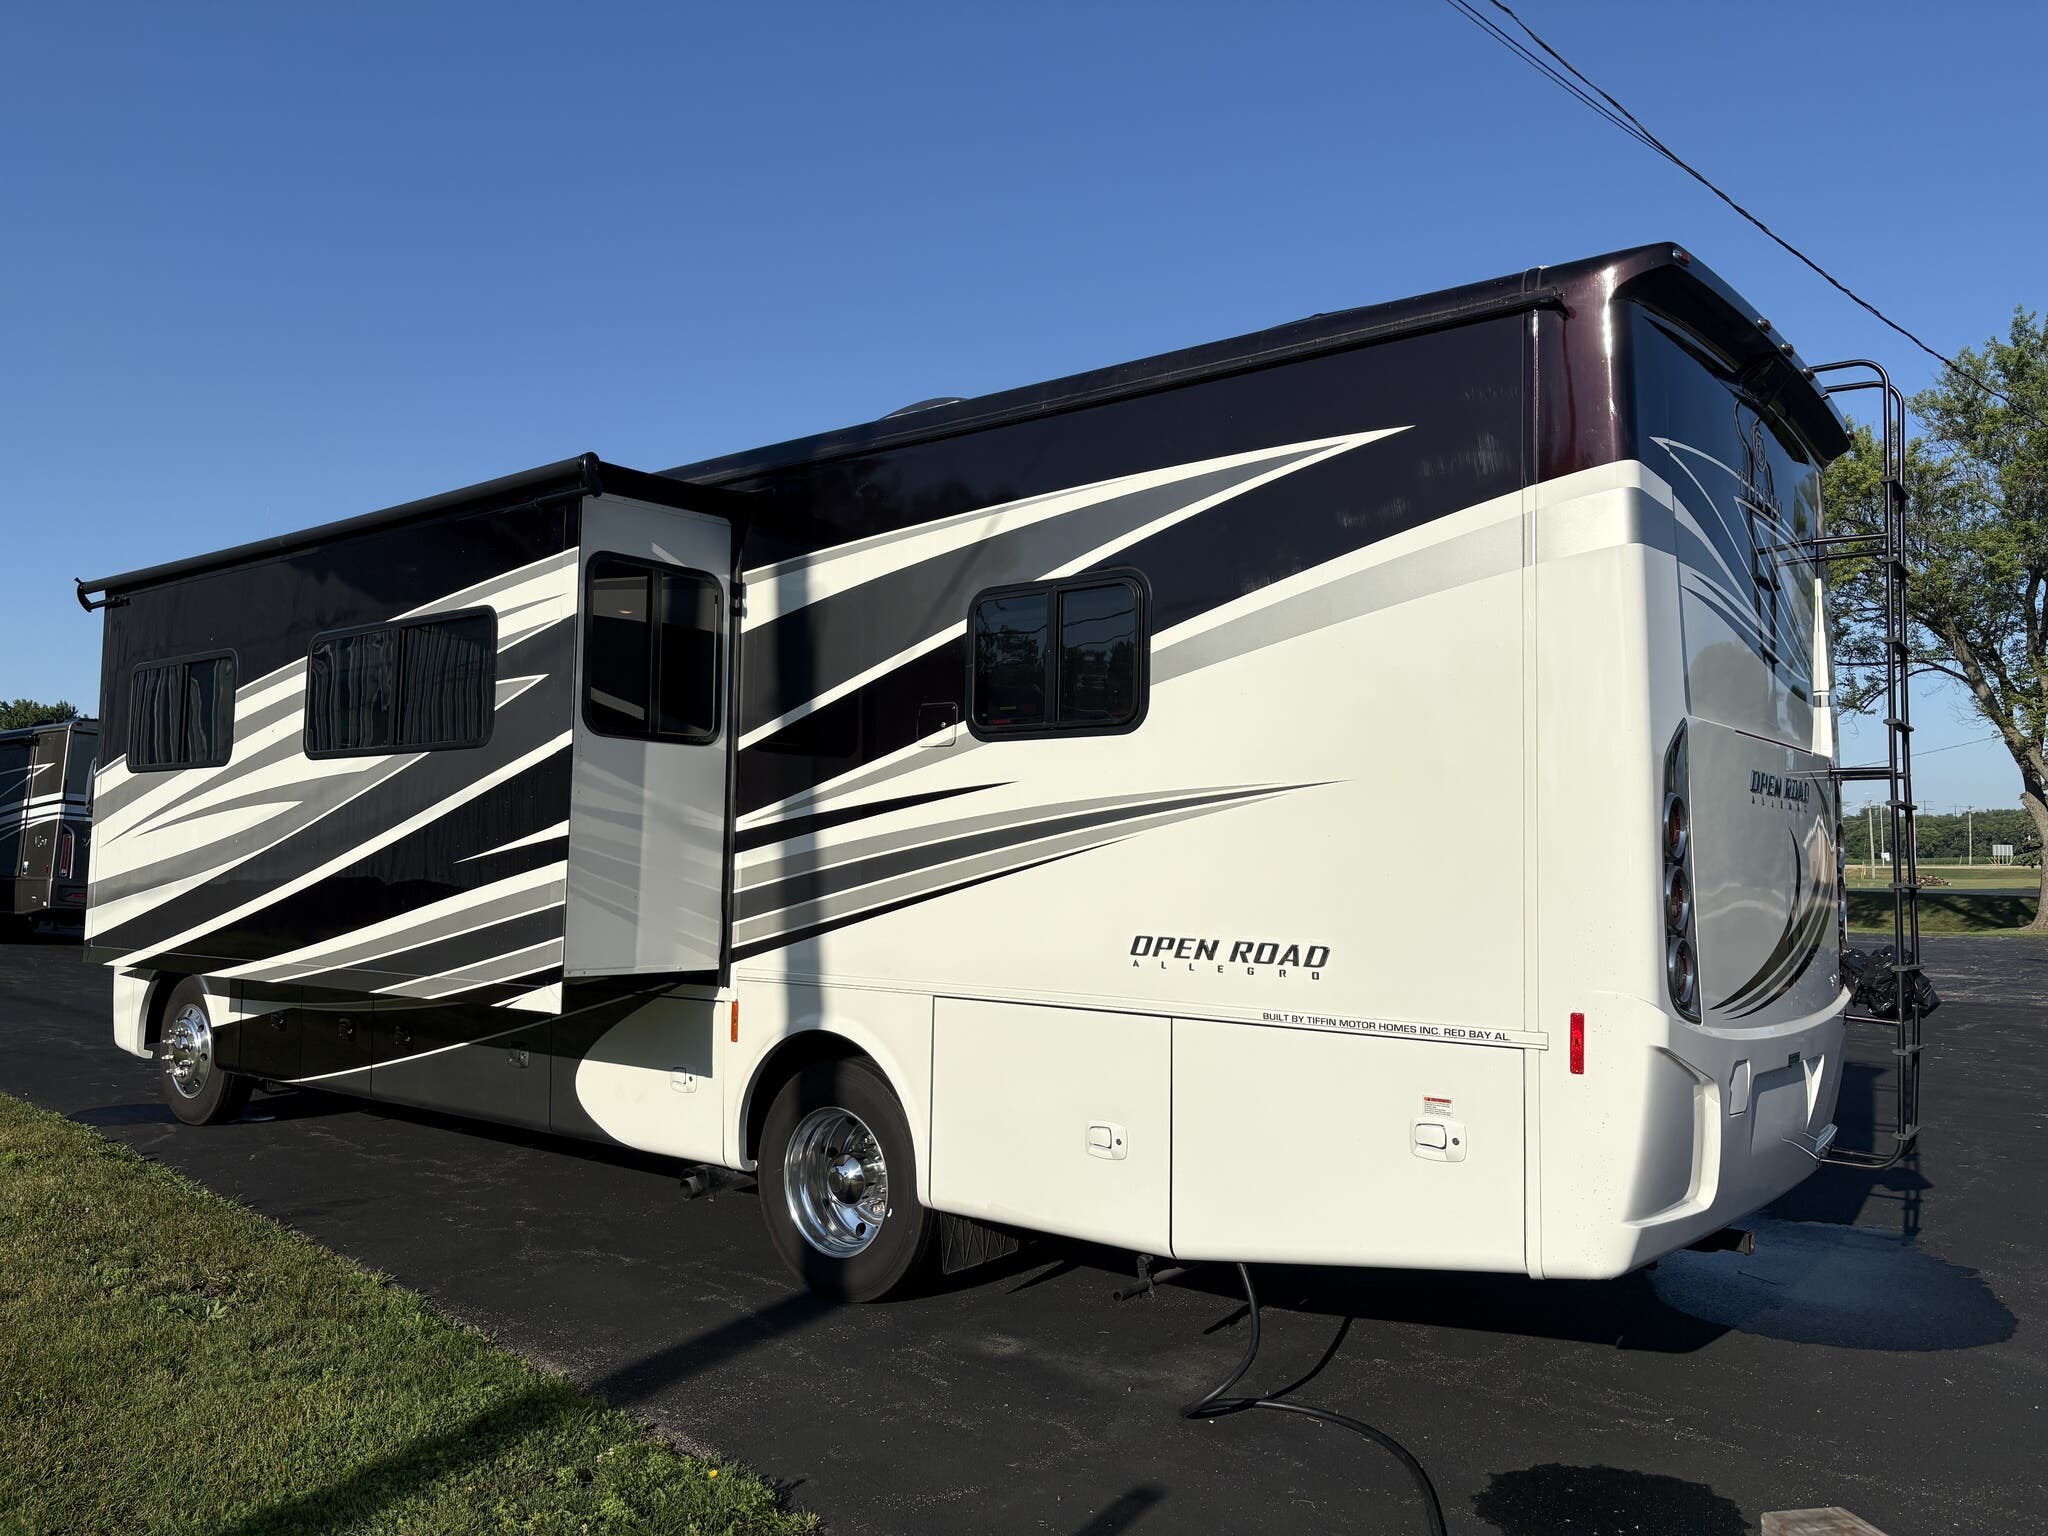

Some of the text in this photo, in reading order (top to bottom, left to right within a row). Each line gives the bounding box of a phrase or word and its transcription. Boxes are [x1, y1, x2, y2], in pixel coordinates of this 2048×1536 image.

[1130, 935, 1331, 968] OPEN ROAD
[1132, 959, 1320, 980] ALLEGRO
[1262, 1012, 1289, 1022] BUILT
[1292, 1014, 1304, 1023] BY
[1307, 1016, 1336, 1026] TIFFIN
[1339, 1019, 1376, 1030] MOTOR
[1379, 1022, 1417, 1033] HOMES
[1444, 1028, 1466, 1038] RED
[1468, 1030, 1491, 1039] BAY
[1494, 1032, 1511, 1042] AL.
